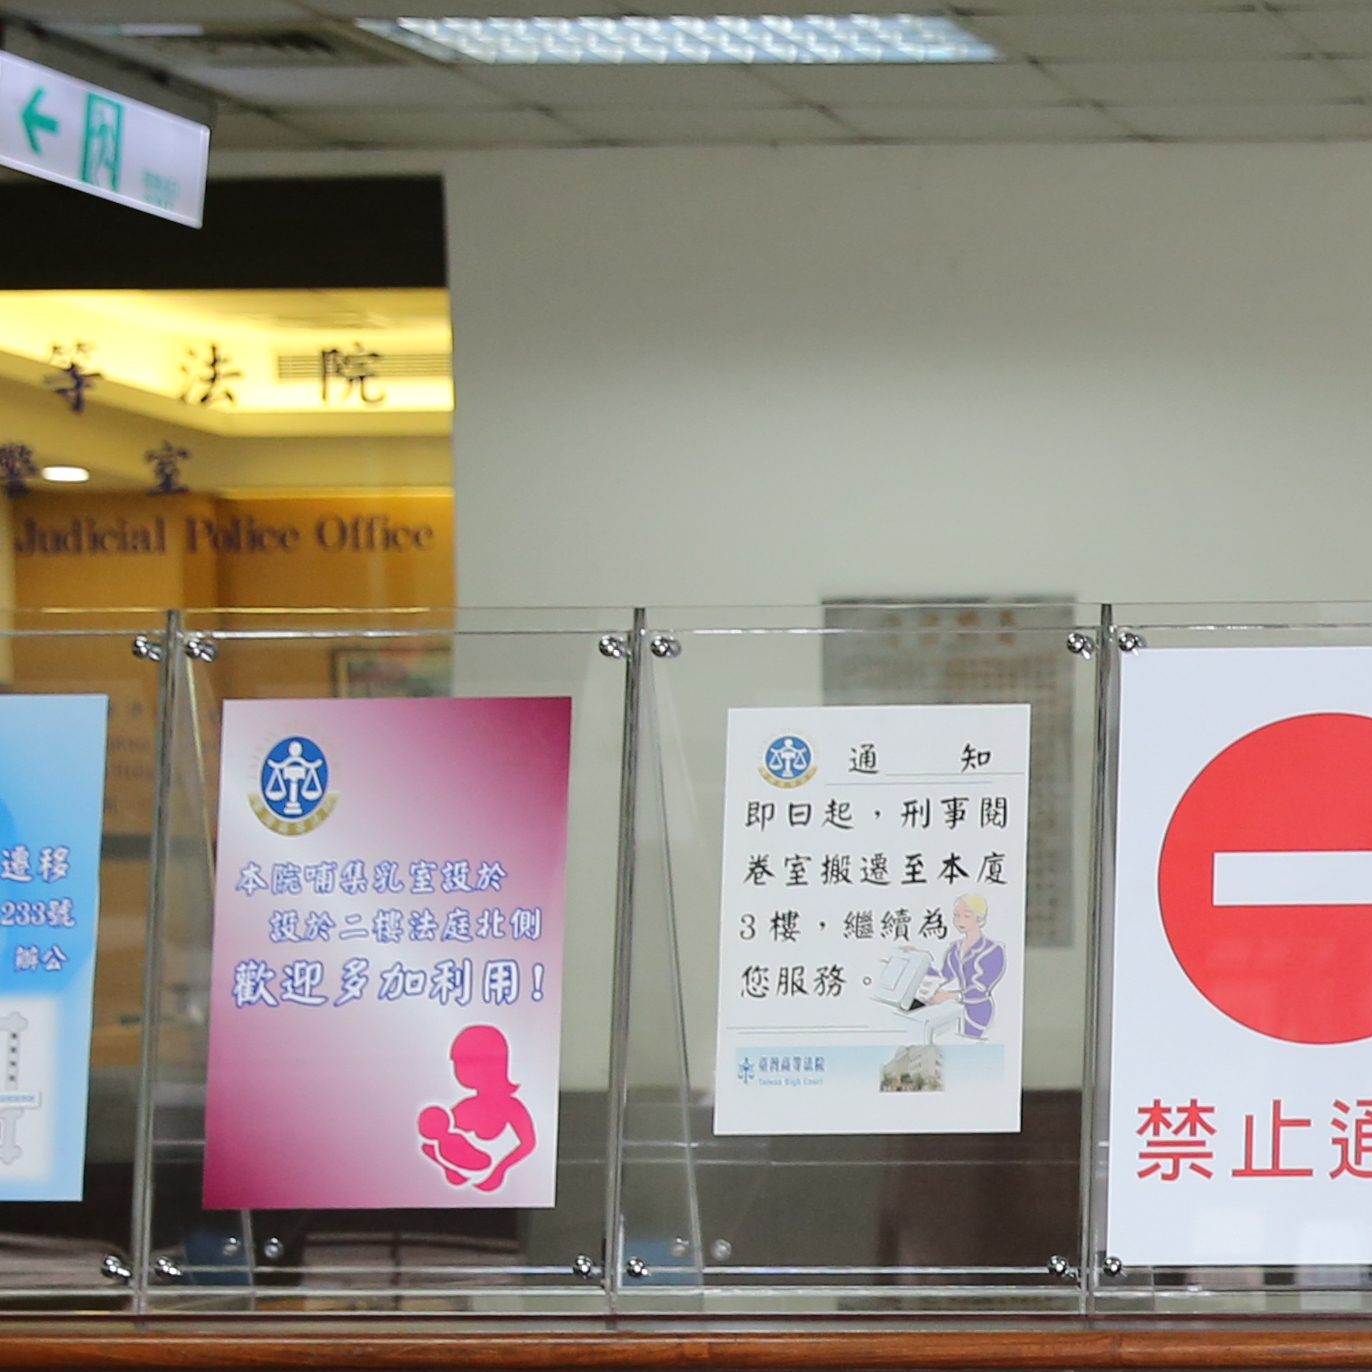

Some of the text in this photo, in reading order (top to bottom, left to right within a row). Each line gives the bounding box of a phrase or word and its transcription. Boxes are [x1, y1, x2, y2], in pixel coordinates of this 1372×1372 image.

[15, 511, 435, 556] Judicial Police Office
[849, 743, 992, 775] 通知
[744, 796, 1008, 832] 即日起，刑事閱
[235, 859, 508, 897] 本院哺集乳室設於
[743, 851, 1008, 887] 卷室搬遷至本廈
[269, 905, 543, 943] 設於二樓法庭北側
[231, 957, 546, 1009] 歡迎多加利用!
[741, 963, 873, 999] 您服務。
